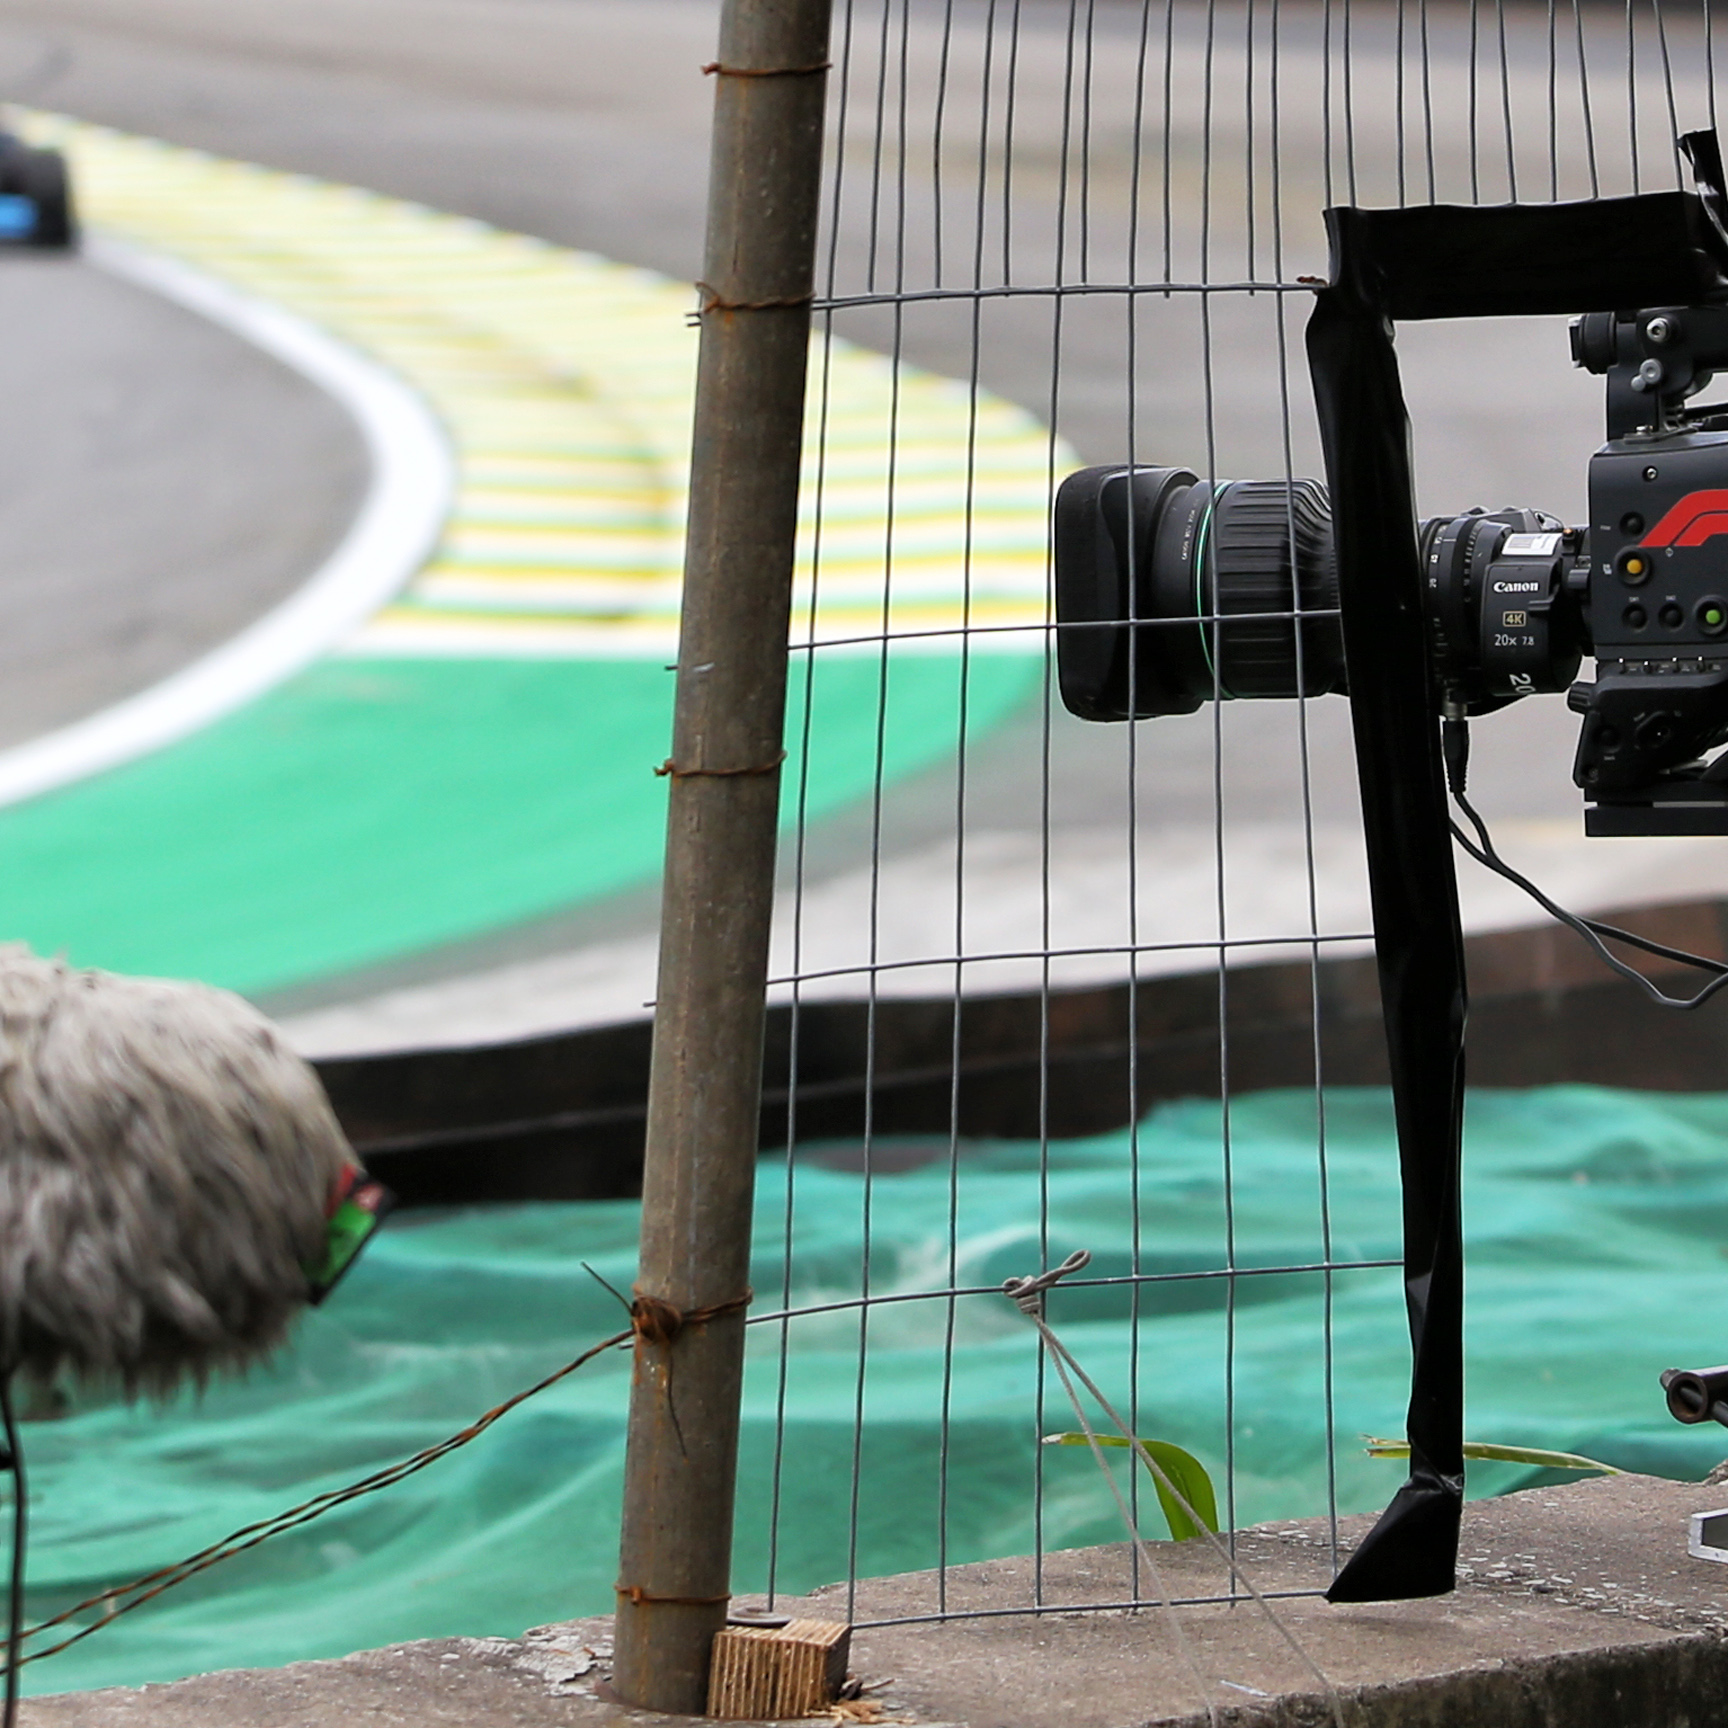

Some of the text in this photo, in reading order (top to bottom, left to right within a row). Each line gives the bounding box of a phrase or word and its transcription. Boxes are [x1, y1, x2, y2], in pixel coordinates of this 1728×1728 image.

[1493, 581, 1539, 593] Canon
[1506, 614, 1523, 624] 4K
[1494, 633, 1517, 647] 20x
